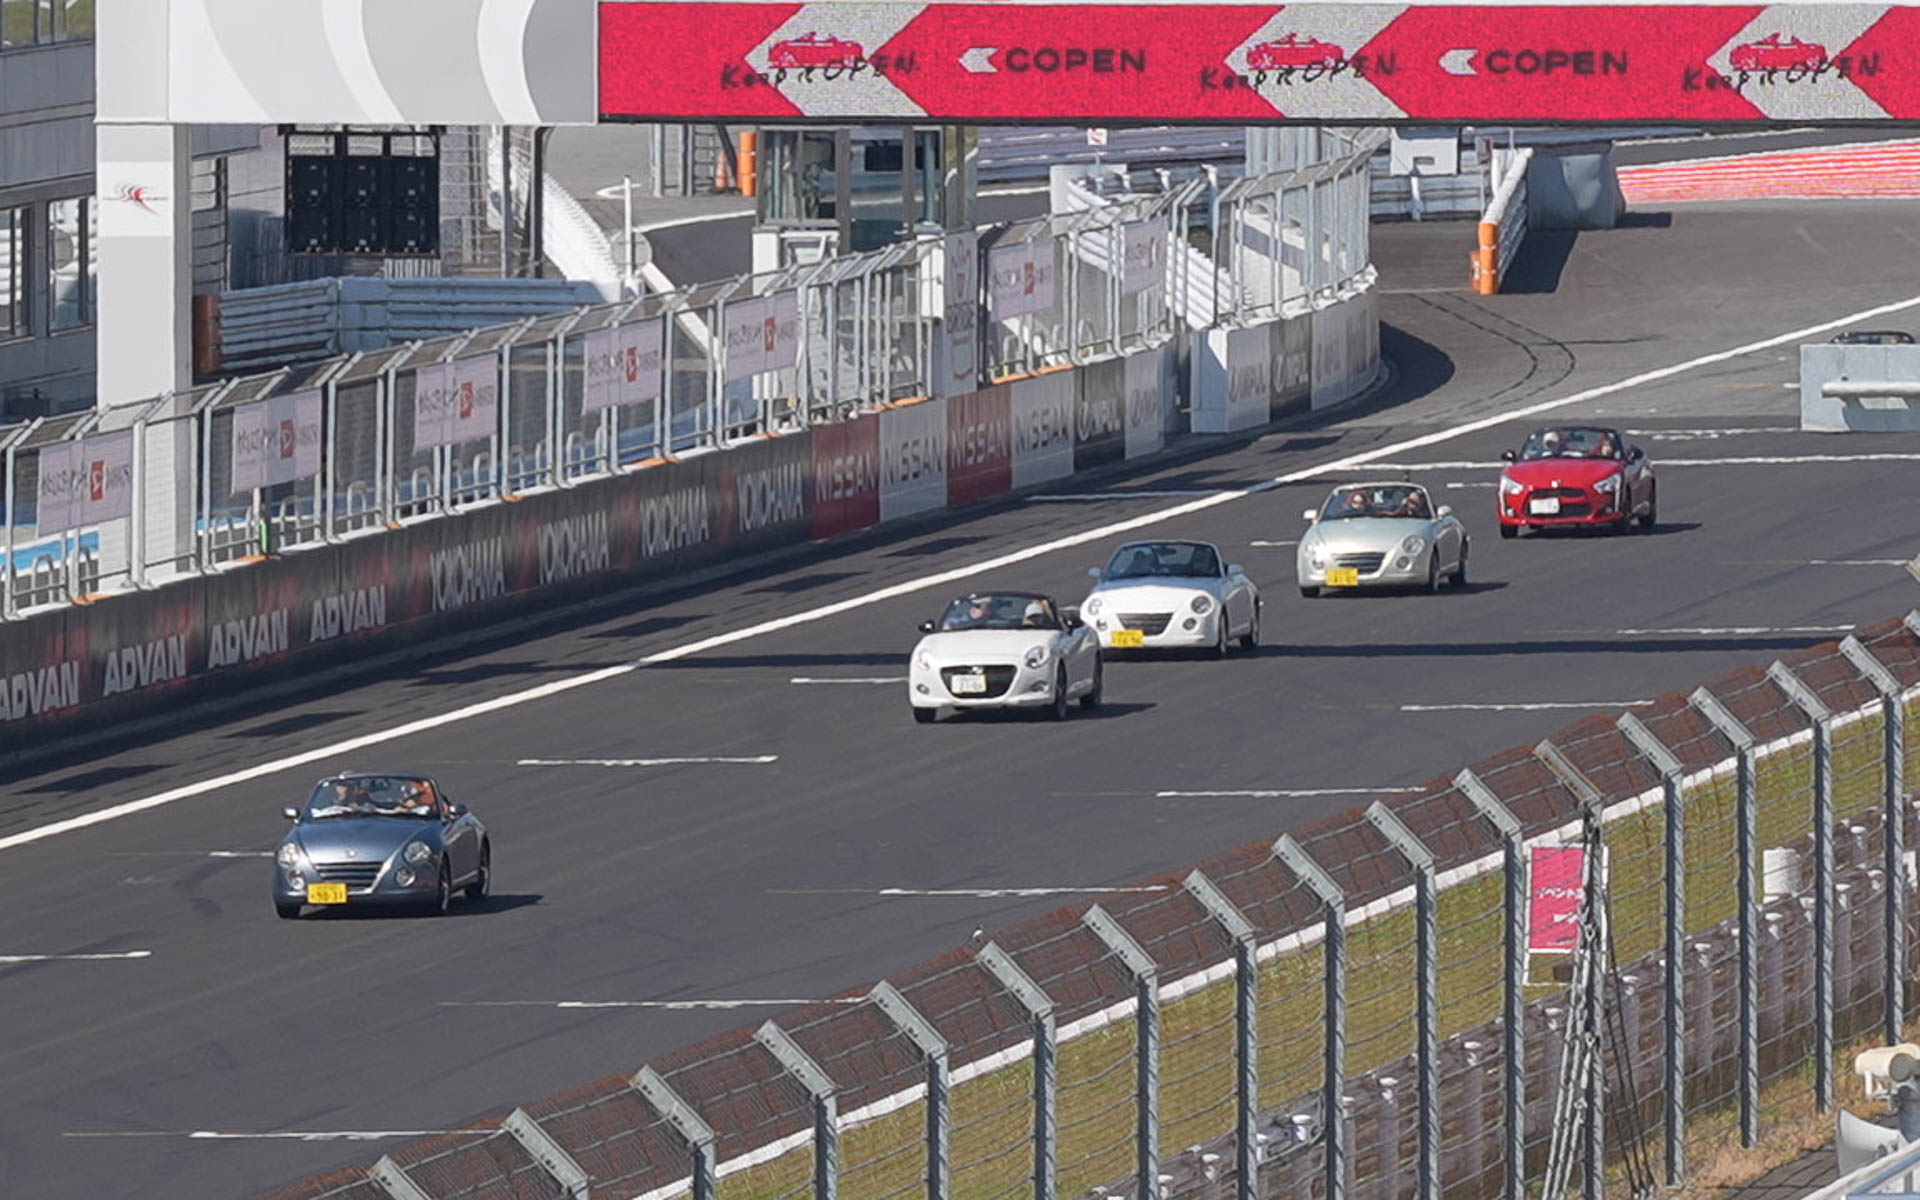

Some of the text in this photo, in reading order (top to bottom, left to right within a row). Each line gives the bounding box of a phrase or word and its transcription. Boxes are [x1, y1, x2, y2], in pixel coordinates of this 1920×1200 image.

[1006, 47, 1146, 73] COPEN
[1485, 49, 1628, 76] COPEN
[951, 420, 1008, 468] NISSAN
[1015, 406, 1070, 455] NISSAN
[816, 453, 875, 503] NISSAN
[884, 435, 943, 484] NISSAN
[207, 607, 289, 669] ADVAN
[309, 584, 386, 643] ADVAN
[103, 634, 187, 697] ADVAN
[0, 661, 80, 721] ADVAN
